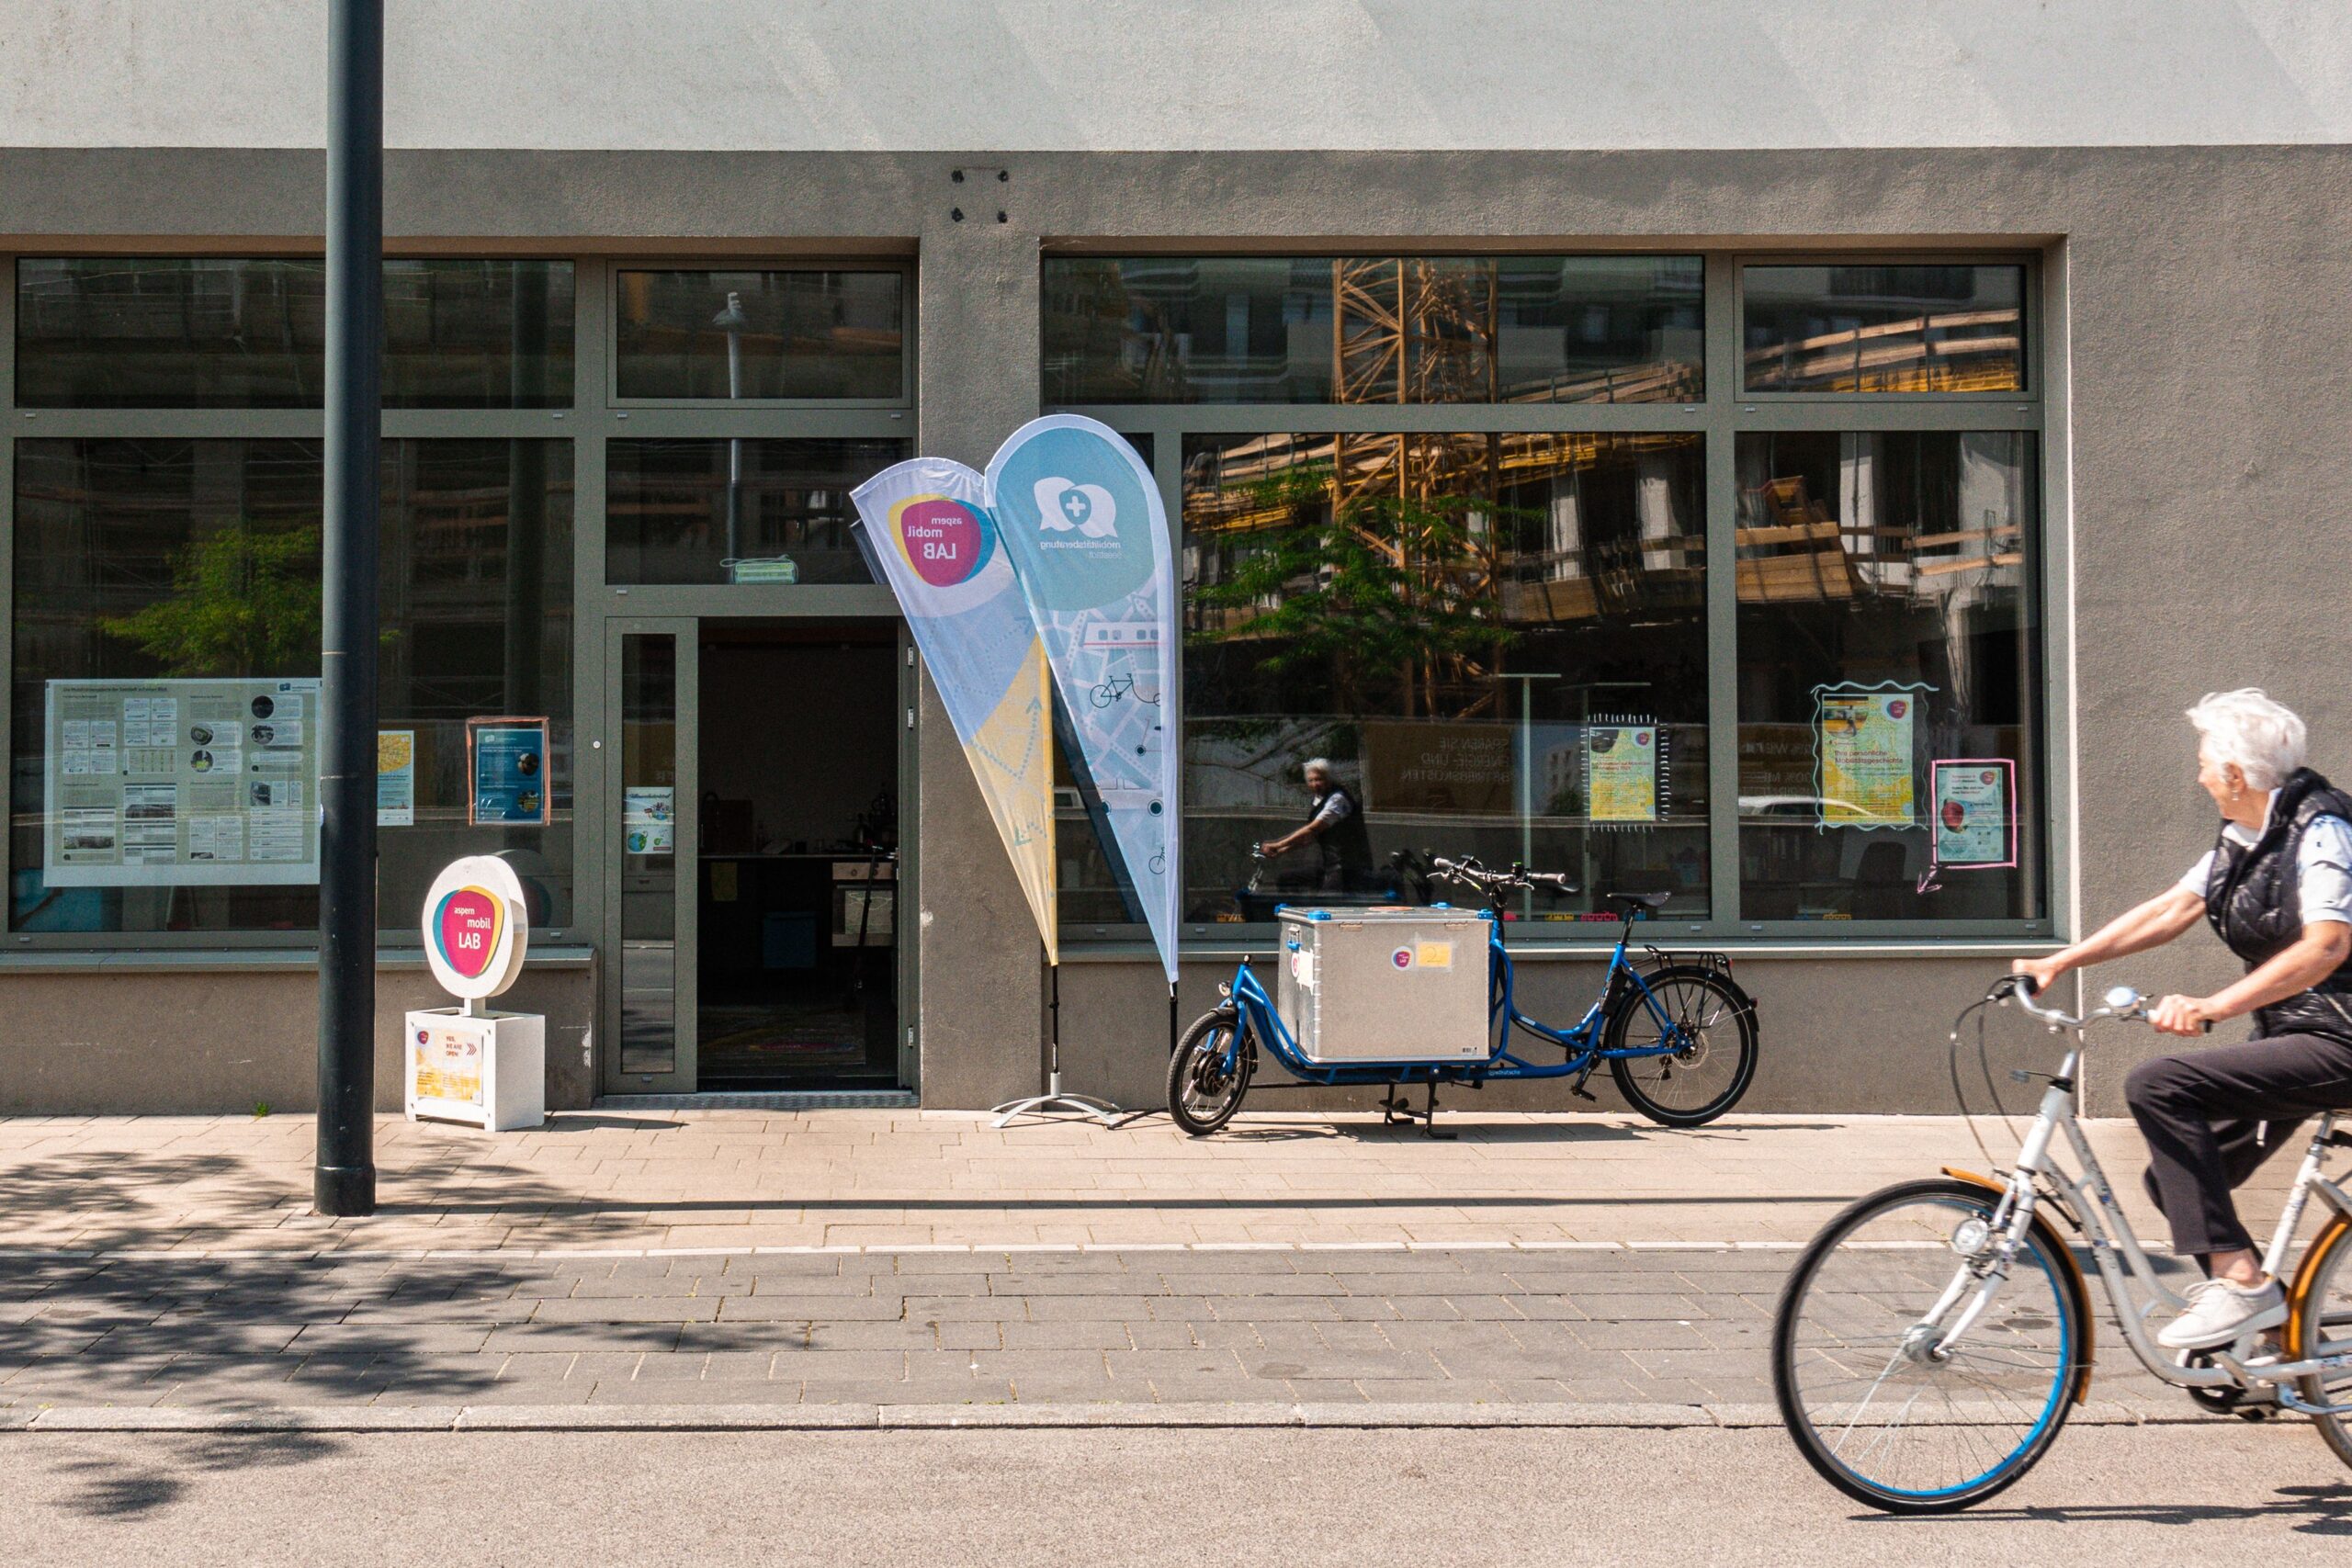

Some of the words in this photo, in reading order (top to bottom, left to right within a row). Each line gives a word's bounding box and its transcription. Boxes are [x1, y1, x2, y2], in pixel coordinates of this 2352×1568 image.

[454, 907, 475, 917] aspern
[467, 918, 492, 930] mobil
[458, 932, 481, 949] LAB
[1425, 947, 1442, 963] 2
